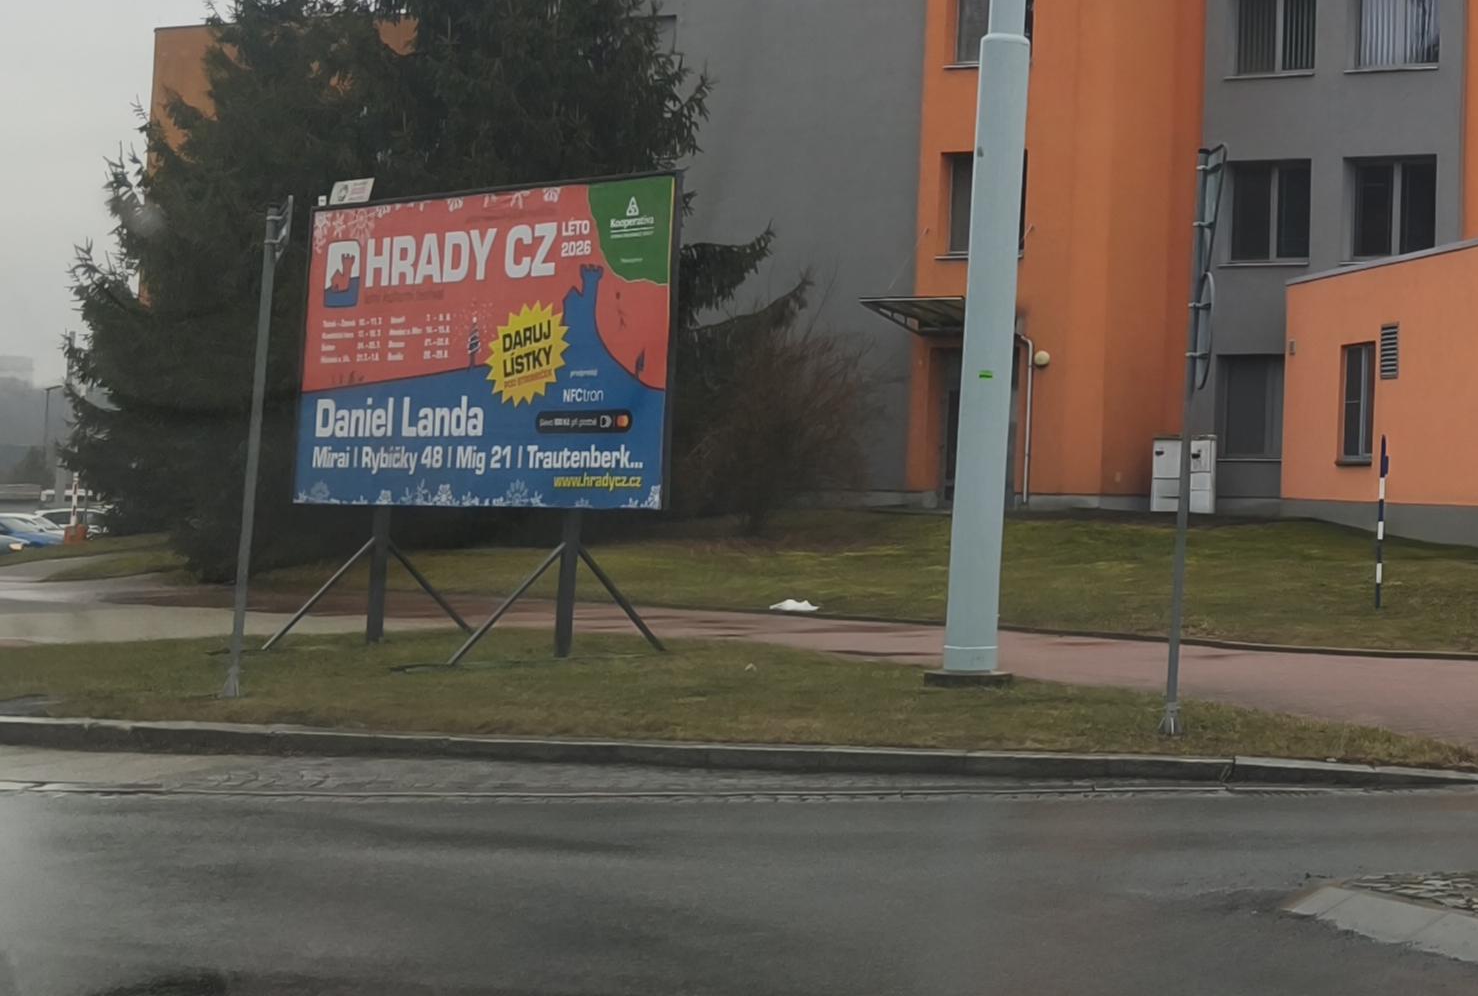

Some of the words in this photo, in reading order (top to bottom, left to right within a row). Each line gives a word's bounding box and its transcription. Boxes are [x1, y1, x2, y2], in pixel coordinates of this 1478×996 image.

[562, 217, 590, 237] LÉTO
[365, 227, 498, 288] HRADY
[504, 221, 558, 279] CZ
[561, 240, 592, 257] 2026
[502, 320, 552, 353] DARUJ
[503, 345, 552, 378] LÍSTKY
[562, 389, 604, 403] NFCtron
[315, 397, 393, 438] Daniel
[402, 395, 484, 437] Landa
[312, 446, 350, 469] Mirai
[421, 445, 442, 469] 48
[456, 445, 486, 475] Mig
[490, 445, 512, 469] 21
[526, 444, 643, 469] Trautenberk...
[553, 473, 642, 492] www.hradycz.cz
